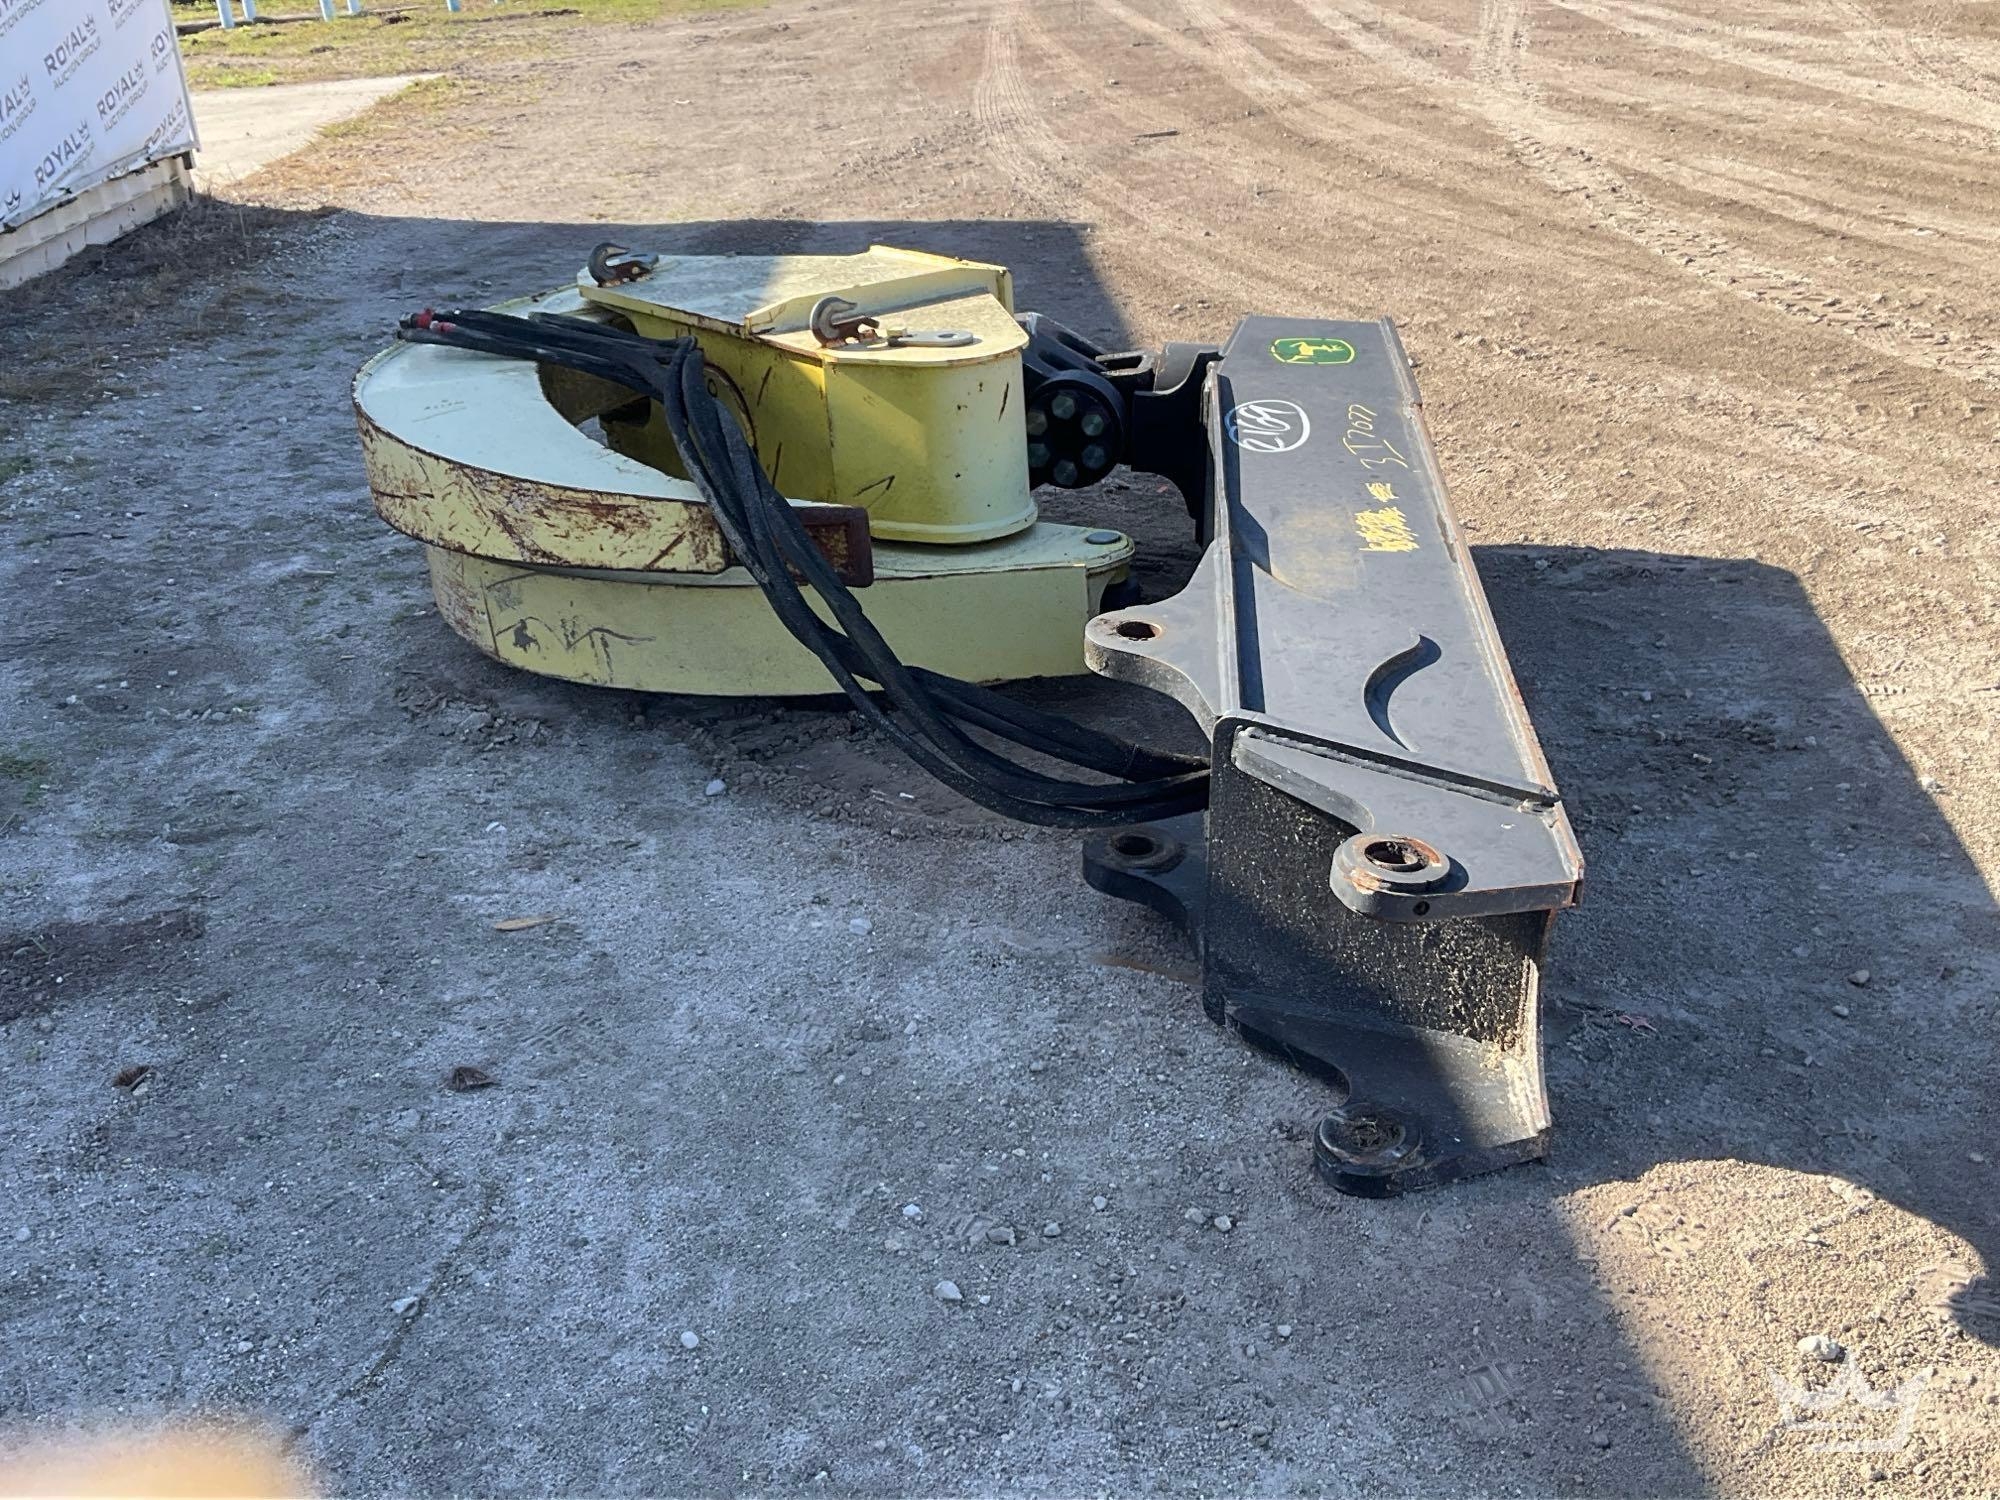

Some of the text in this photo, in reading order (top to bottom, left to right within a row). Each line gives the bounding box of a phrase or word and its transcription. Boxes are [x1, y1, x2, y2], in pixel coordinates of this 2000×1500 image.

[43, 25, 87, 76] ROYAL
[96, 70, 138, 121] ROYAL
[35, 133, 82, 188] ROYAL
